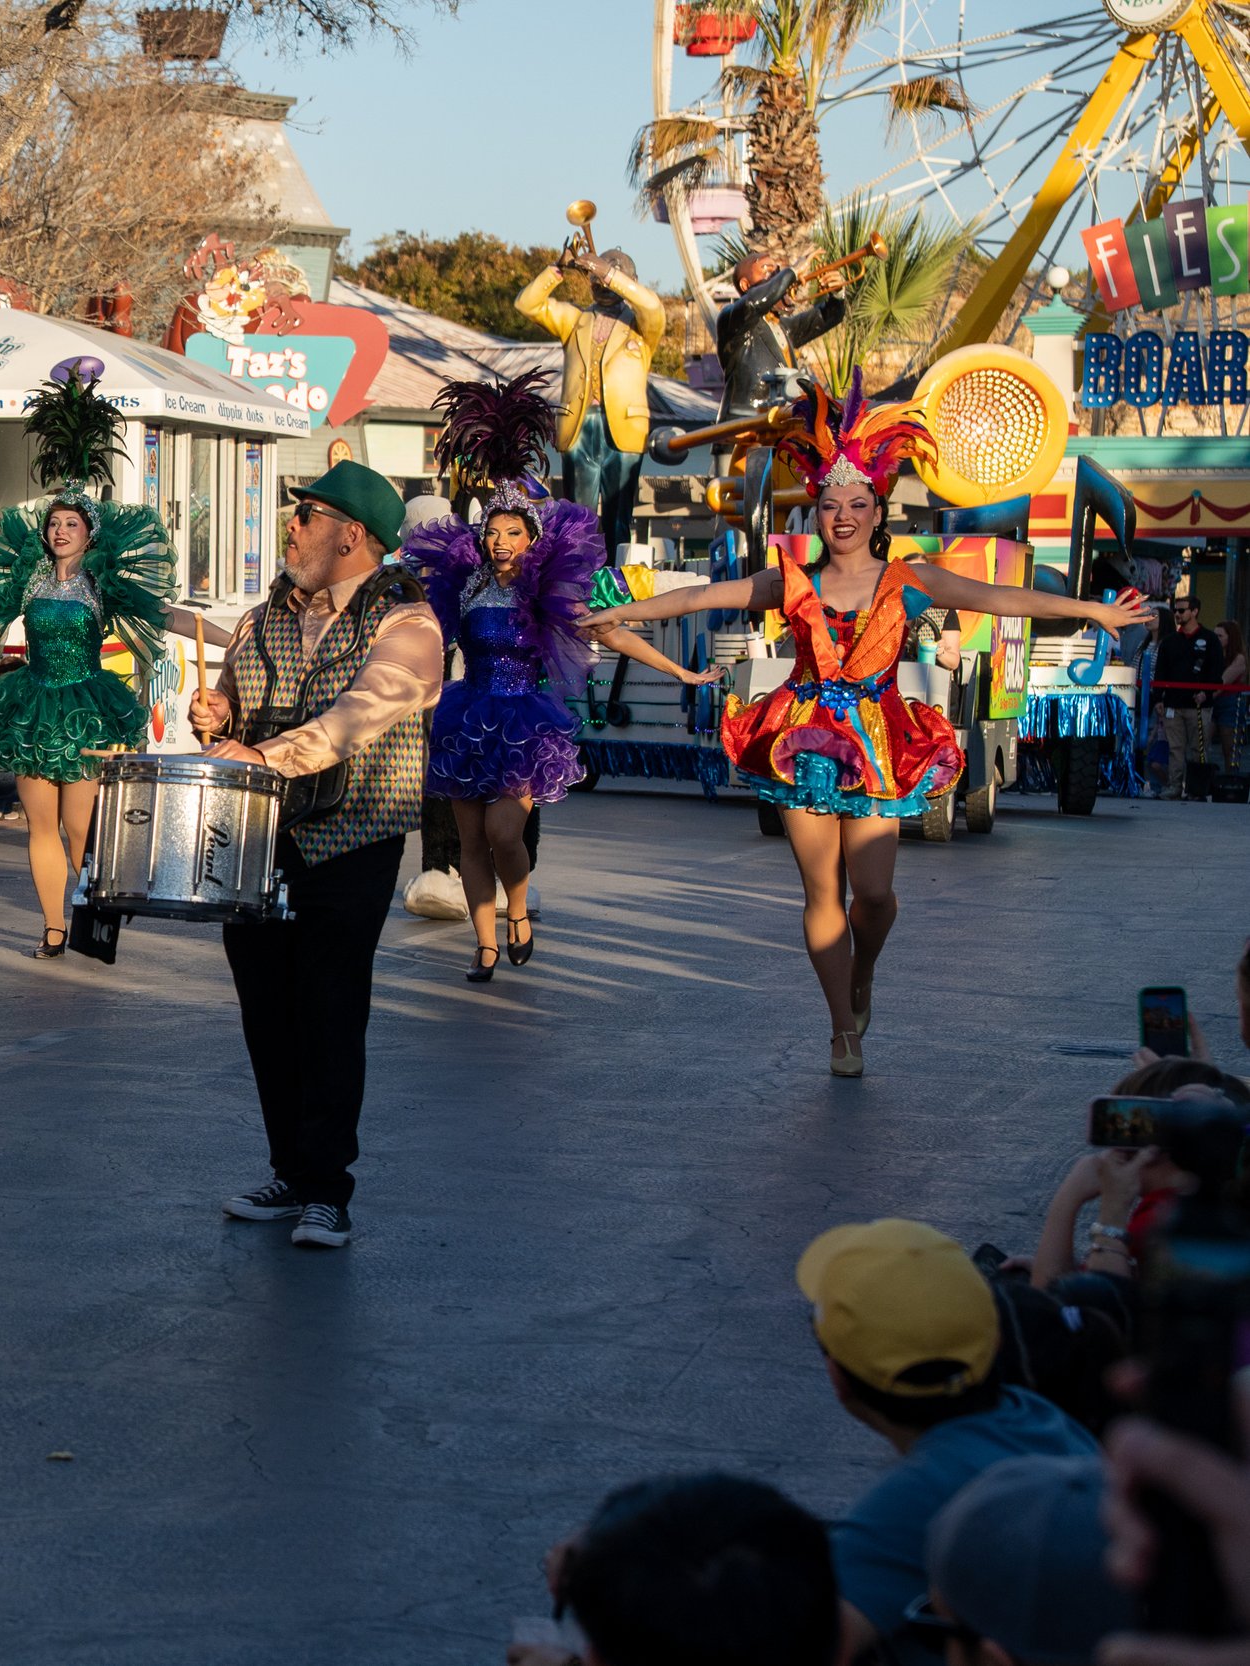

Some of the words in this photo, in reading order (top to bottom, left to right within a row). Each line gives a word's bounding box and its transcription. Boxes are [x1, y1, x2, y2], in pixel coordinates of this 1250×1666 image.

[226, 344, 307, 380] Taz's
[1082, 330, 1250, 408] BOAR
[165, 393, 177, 409] Ice
[179, 396, 206, 414] Cream
[246, 407, 264, 423] dots
[274, 411, 285, 427] Ice
[287, 413, 309, 431] Cream
[1004, 641, 1025, 691] GRAS
[204, 815, 232, 887] Pearl
